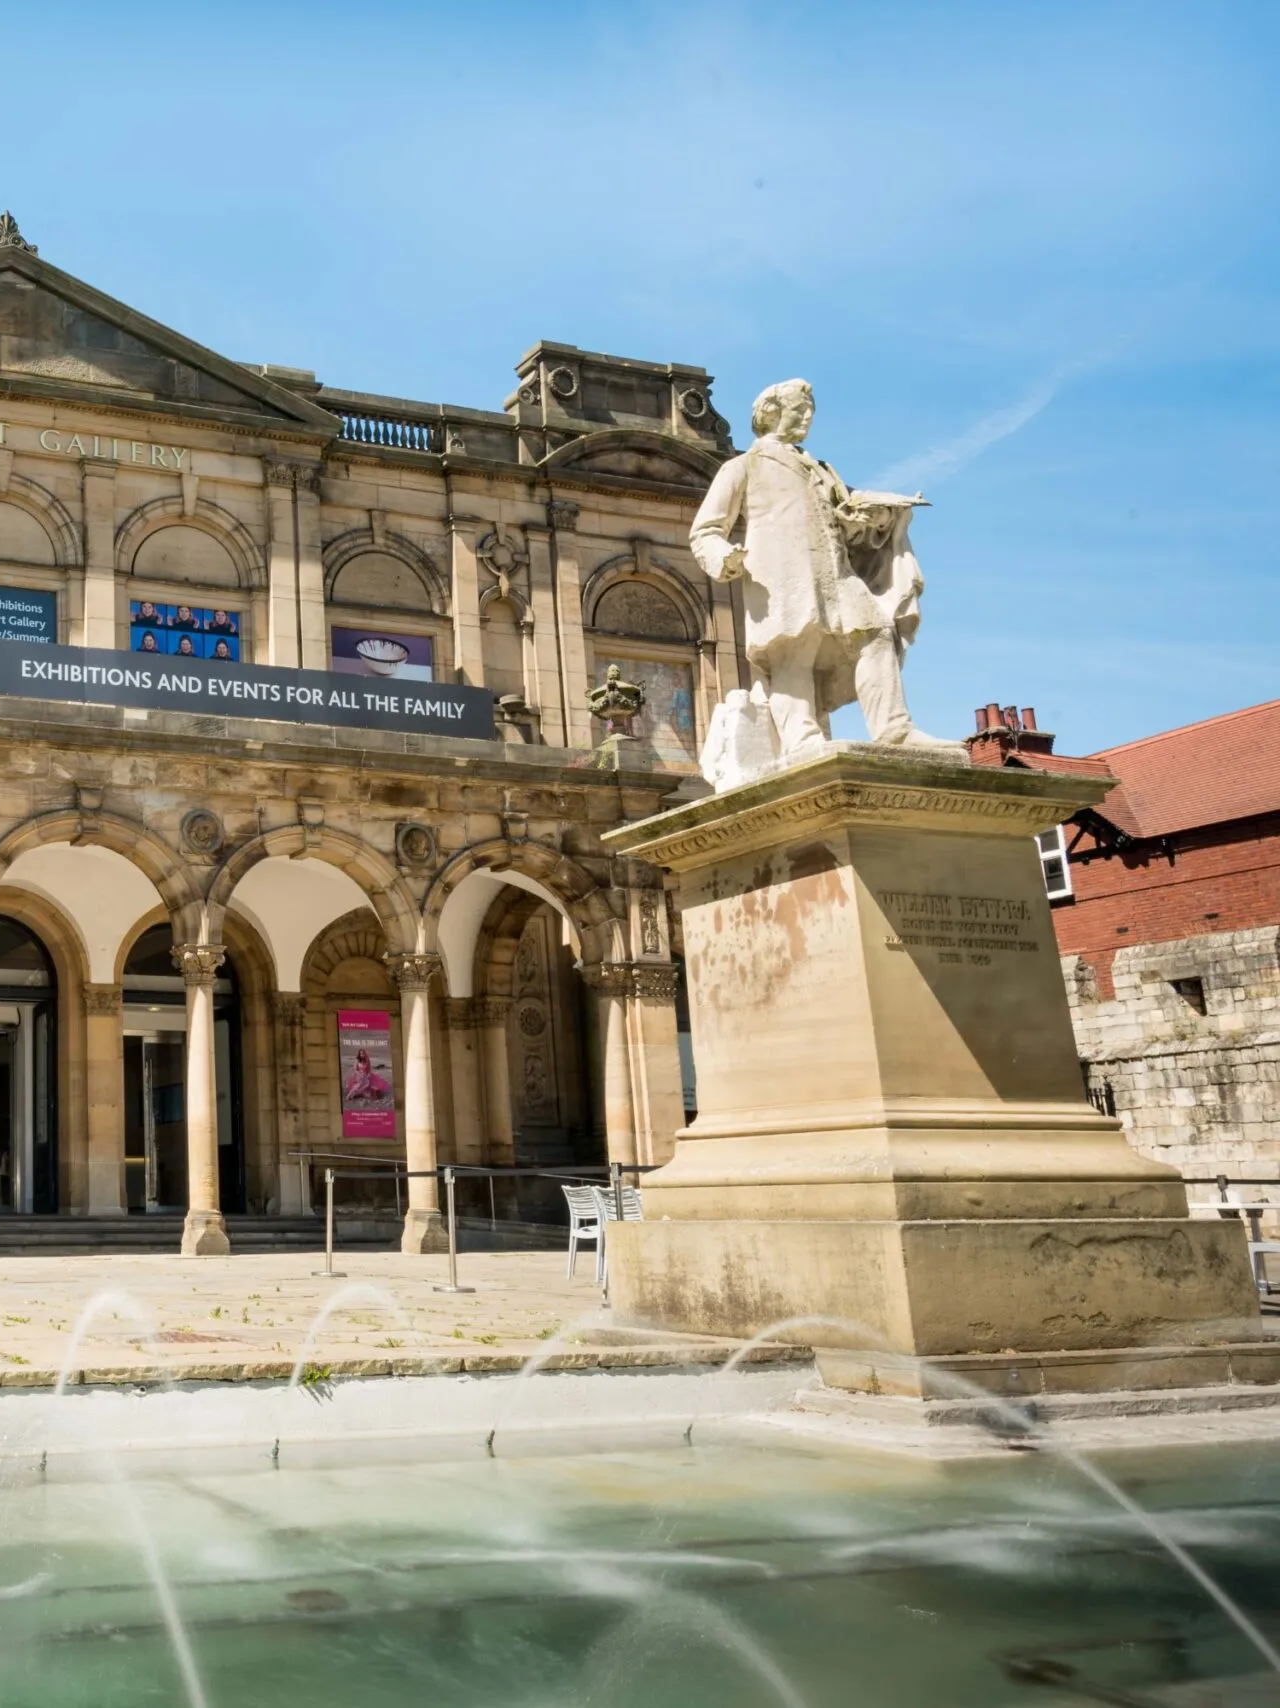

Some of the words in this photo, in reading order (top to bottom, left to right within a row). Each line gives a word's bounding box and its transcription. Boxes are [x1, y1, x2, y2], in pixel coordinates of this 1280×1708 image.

[39, 429, 188, 469] GALLERY
[8, 616, 46, 631] Gallery
[21, 660, 152, 690] EXHIBITIONS
[158, 674, 202, 694] AND
[208, 679, 281, 702] EVENTS
[286, 687, 324, 706] FOR
[328, 691, 360, 710] ALL
[364, 694, 399, 713] THE
[404, 698, 465, 720] FAMILY
